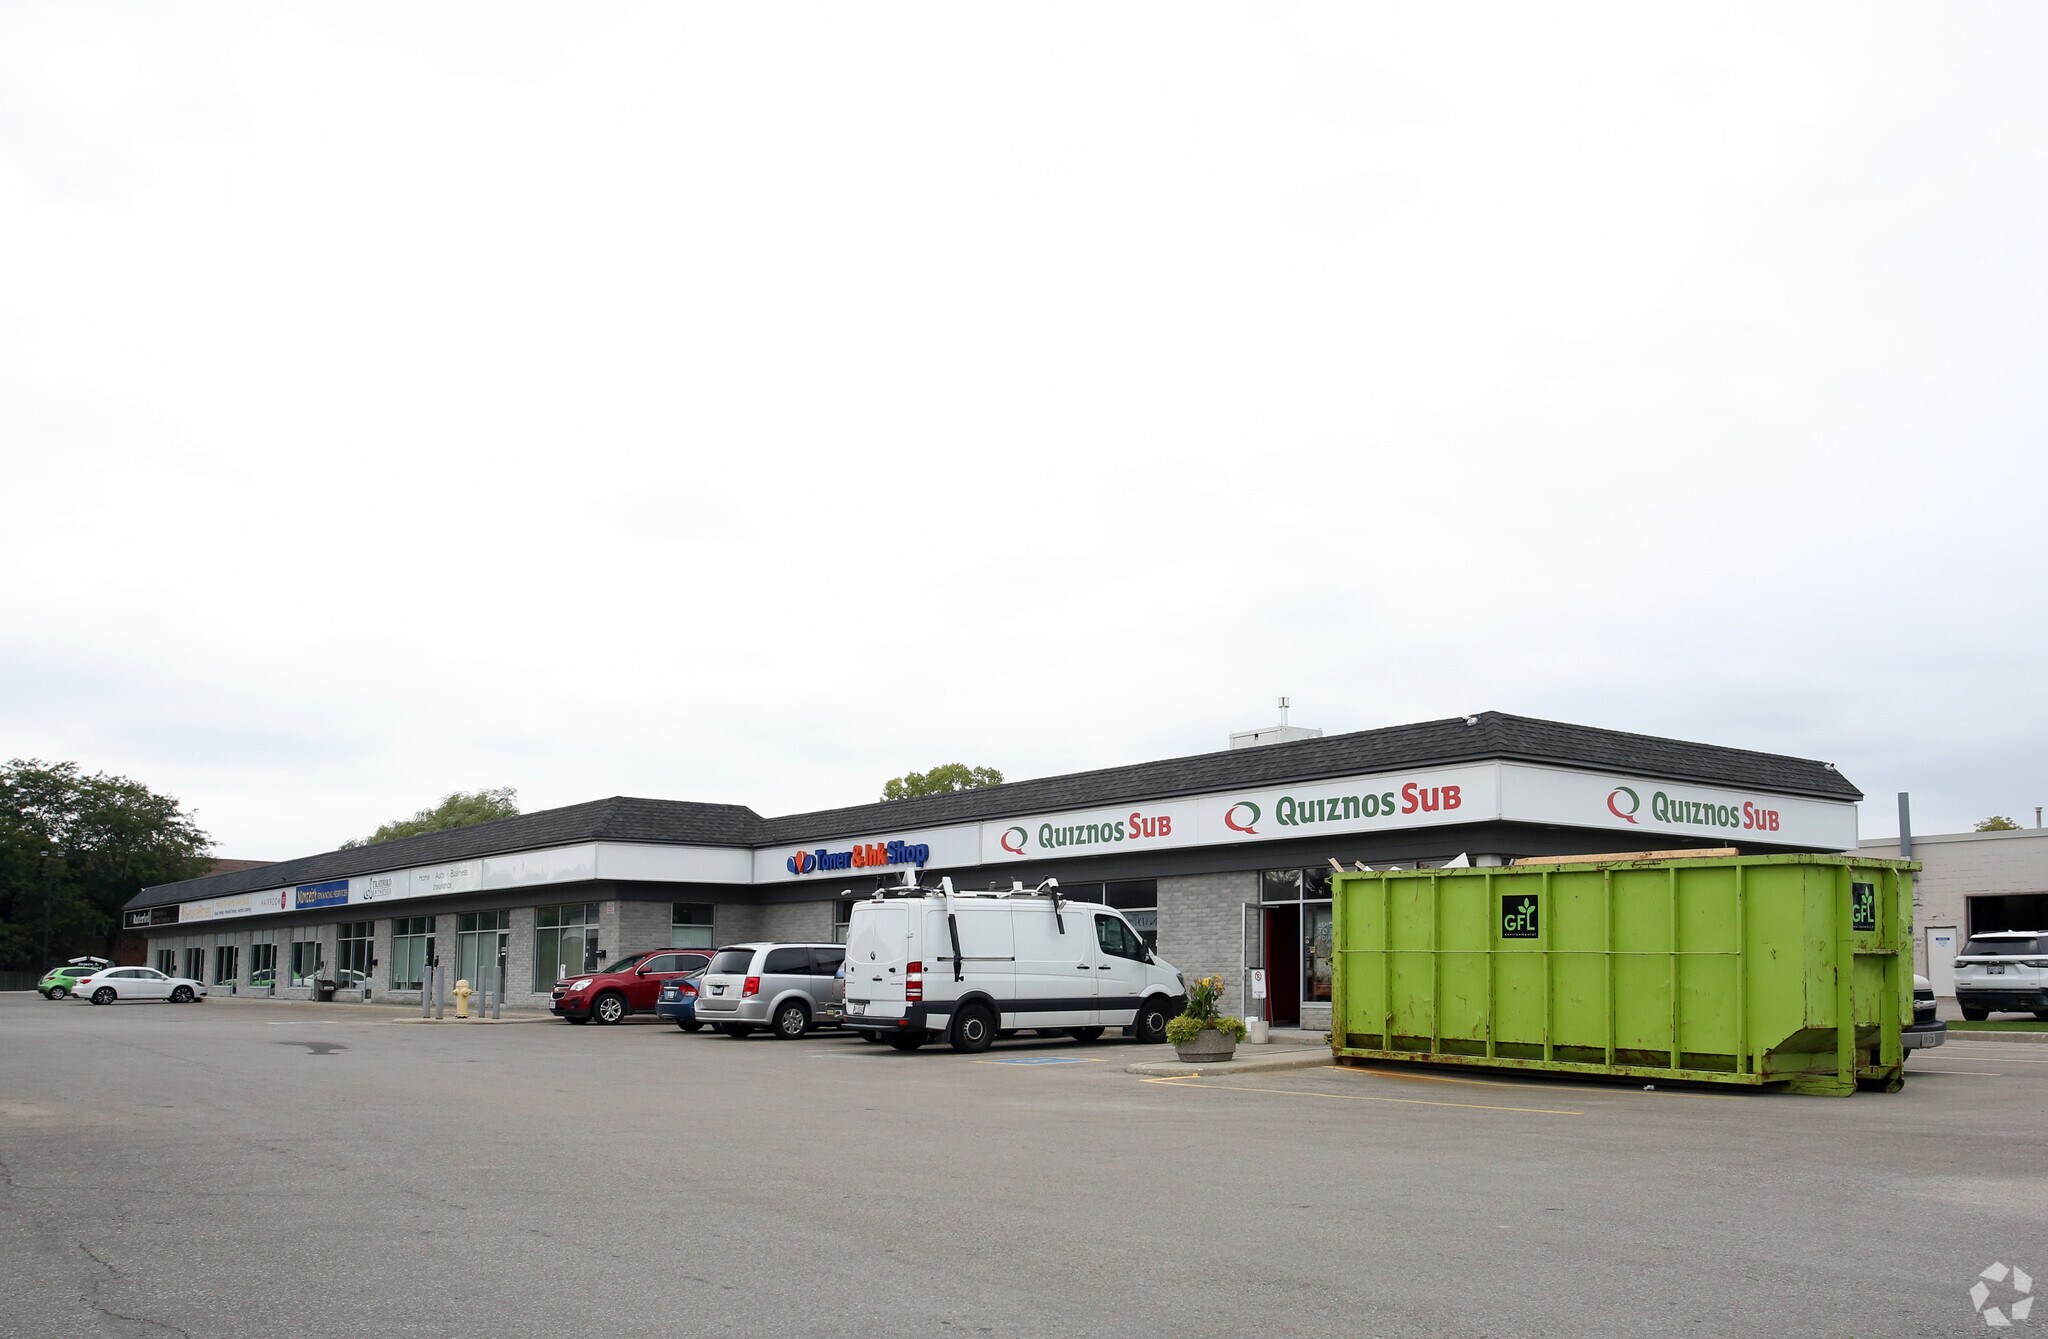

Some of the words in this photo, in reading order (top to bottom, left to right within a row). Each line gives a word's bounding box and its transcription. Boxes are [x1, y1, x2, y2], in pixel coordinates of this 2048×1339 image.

[815, 849, 852, 871] Toner
[852, 845, 865, 868] &
[865, 842, 888, 866] Ink
[887, 840, 929, 868] Shop
[1504, 910, 1536, 931] GFL
[1852, 901, 1875, 922] GFL
